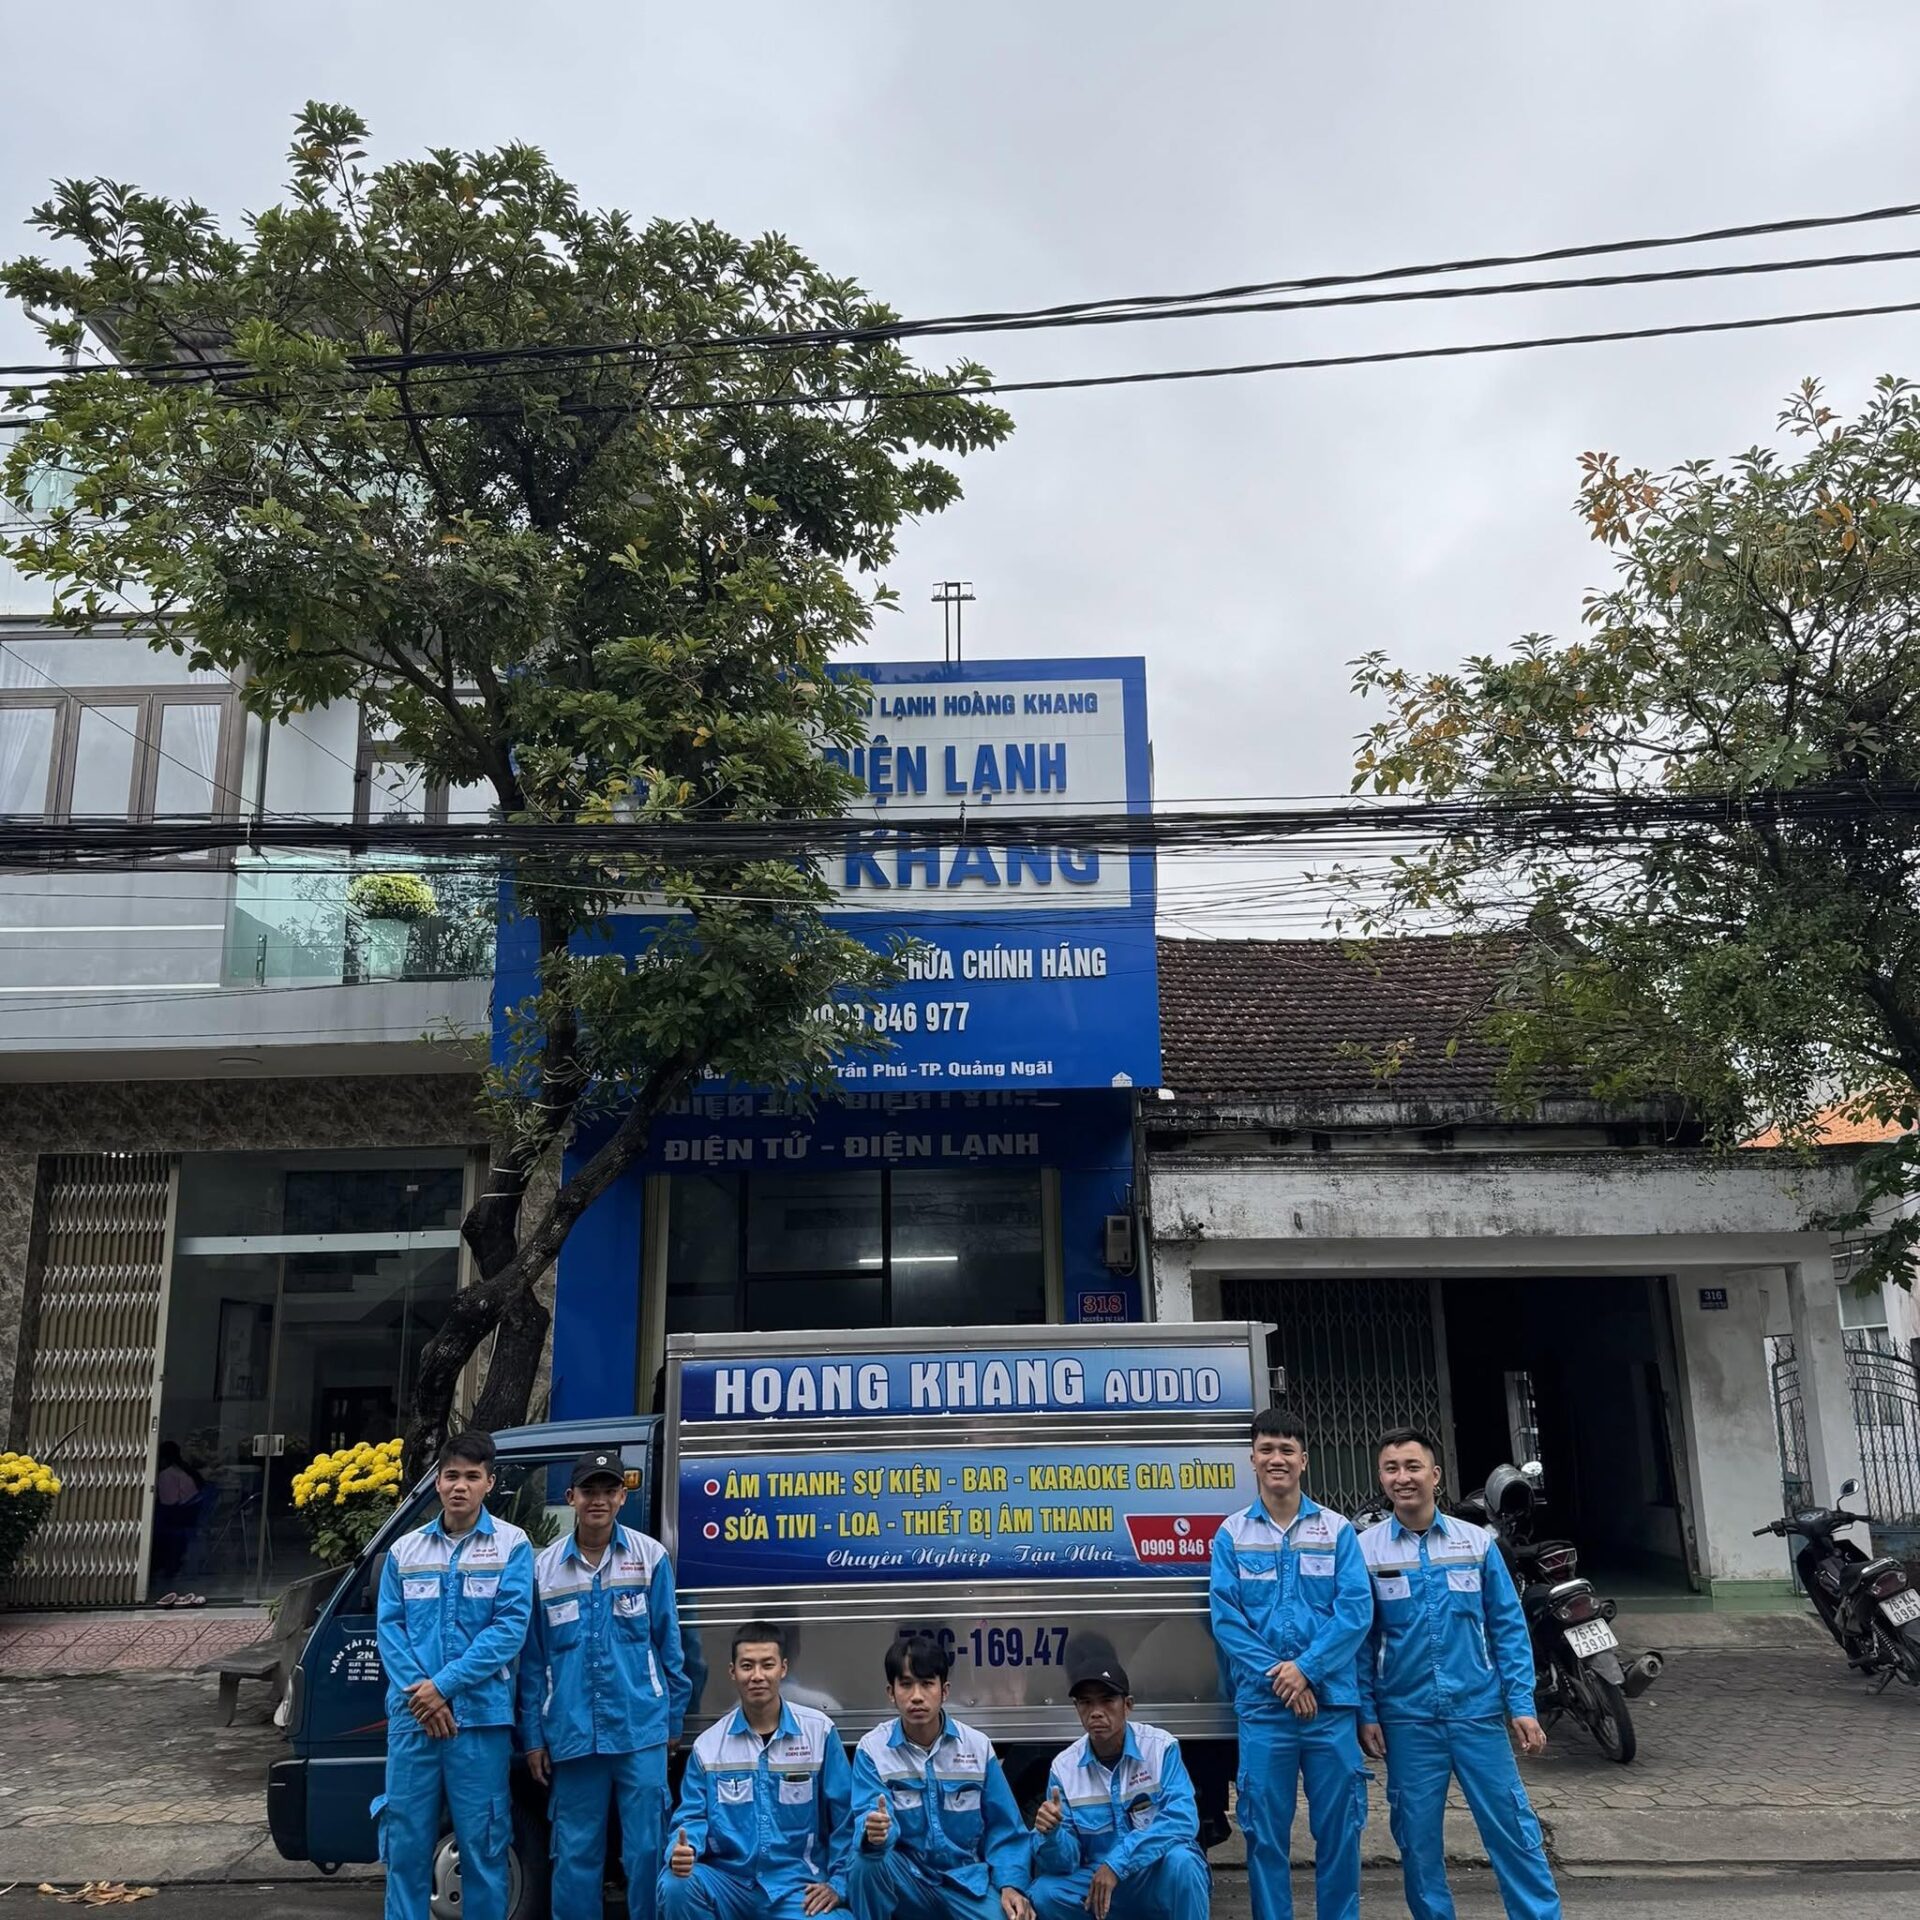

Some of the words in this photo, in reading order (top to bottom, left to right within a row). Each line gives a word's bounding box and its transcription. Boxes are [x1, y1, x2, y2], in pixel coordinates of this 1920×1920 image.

[881, 696, 936, 721] LẠNH
[1024, 692, 1098, 715] KHANG
[945, 743, 1066, 805] LẠNH
[846, 829, 1100, 888] KHANG
[963, 944, 1033, 979] CHÍNH
[1042, 941, 1107, 977] HÃNG
[874, 1002, 917, 1032] 846
[926, 1002, 970, 1031] 977
[873, 1062, 907, 1077] Phú
[949, 1060, 1005, 1077] Quảng
[1011, 1060, 1053, 1077] Ngãi
[664, 1135, 752, 1165] ĐIỆN
[762, 1130, 812, 1160] TỬ
[844, 1130, 932, 1162] ĐIỆN
[941, 1133, 1040, 1161] LẠNH
[1083, 1295, 1122, 1313] 318
[715, 1363, 890, 1415] HOANG
[910, 1358, 1085, 1408] KHANG
[1105, 1368, 1221, 1403] AUDIO
[724, 1470, 760, 1499] ÂM
[766, 1471, 846, 1497] THANH:
[852, 1467, 885, 1500] SỰ
[888, 1464, 941, 1498] KIỆN
[963, 1466, 1007, 1492] BAR
[1029, 1464, 1130, 1491] KARAOKE
[1136, 1463, 1174, 1489] GIA
[1179, 1458, 1235, 1489] ĐÌNH
[724, 1507, 769, 1541] SỬA
[775, 1513, 816, 1539] TIVI
[839, 1512, 880, 1537] LOA
[902, 1501, 962, 1536] THIẾT
[968, 1508, 991, 1538] BỊ
[998, 1503, 1034, 1533] ÂM
[1040, 1506, 1114, 1532] THANH
[827, 1549, 904, 1569] Chuyên
[911, 1547, 992, 1567] Nghiệp
[1064, 1543, 1114, 1562] Nhà
[1141, 1539, 1175, 1557] 0909
[1179, 1539, 1204, 1556] 846
[899, 1627, 1069, 1667] C-169.47
